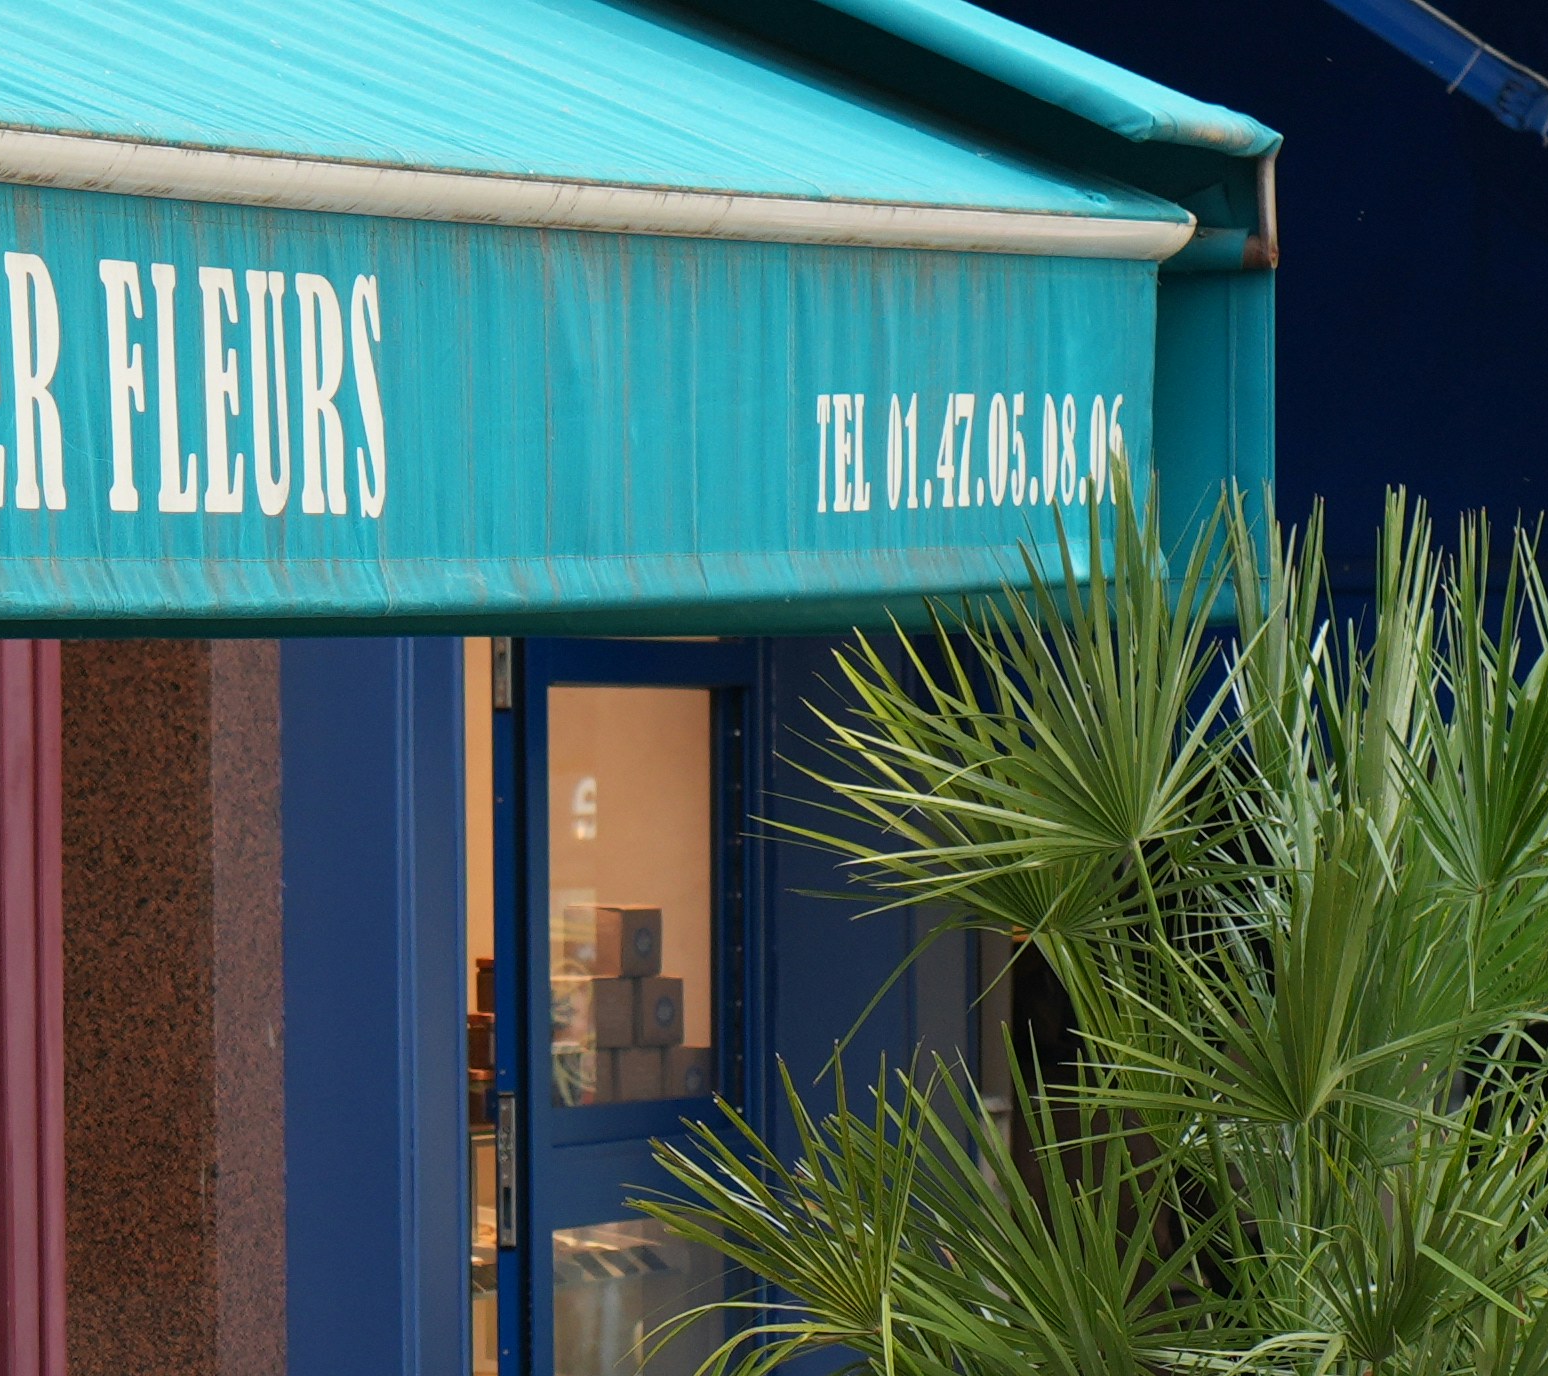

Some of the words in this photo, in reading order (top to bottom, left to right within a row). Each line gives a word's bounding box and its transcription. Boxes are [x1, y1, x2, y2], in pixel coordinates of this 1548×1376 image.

[99, 260, 385, 518] FLEURS
[817, 393, 870, 512] TEL
[887, 391, 1123, 510] 01.47.05.08.06
